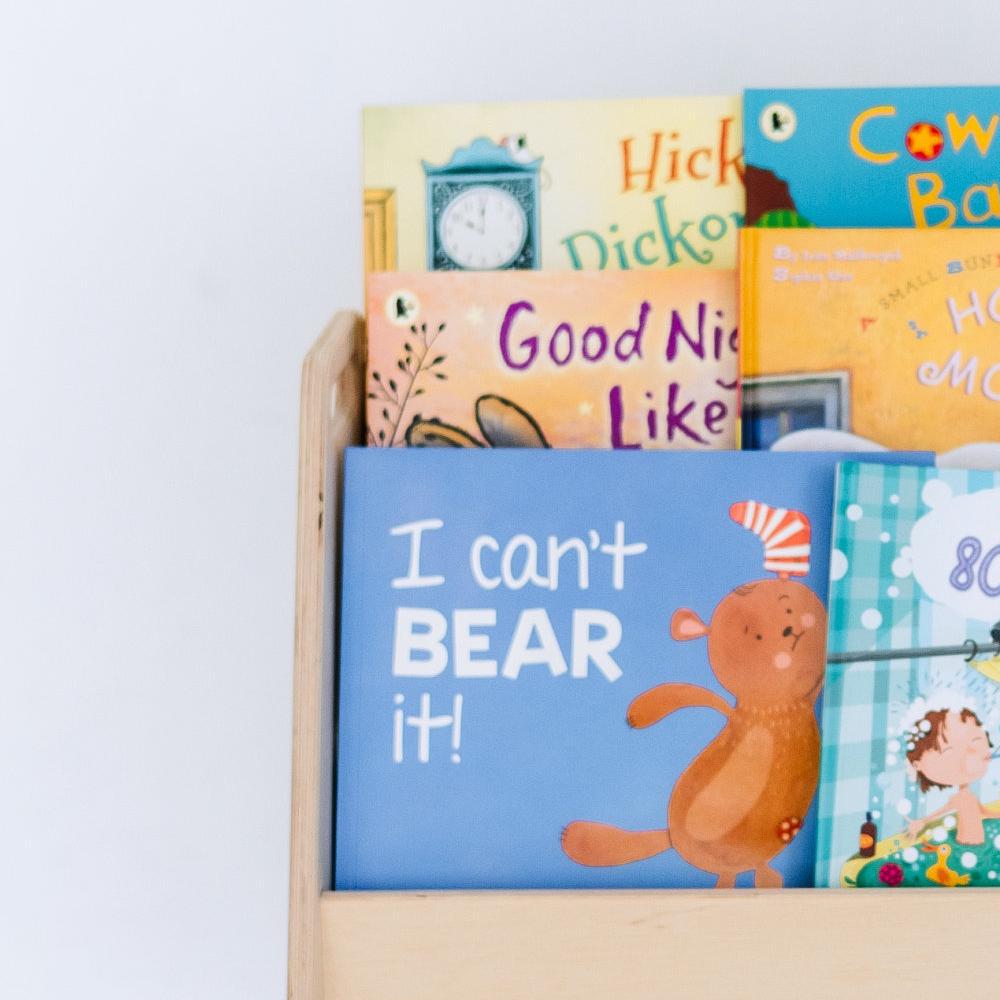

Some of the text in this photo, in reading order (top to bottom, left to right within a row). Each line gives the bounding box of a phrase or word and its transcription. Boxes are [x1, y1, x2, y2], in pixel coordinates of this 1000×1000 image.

[879, 270, 939, 310] SMALL
[500, 300, 652, 371] Good
[609, 382, 728, 449] Like
[390, 518, 649, 591] I can't
[392, 606, 624, 683] BEAR
[393, 692, 463, 763] it!
